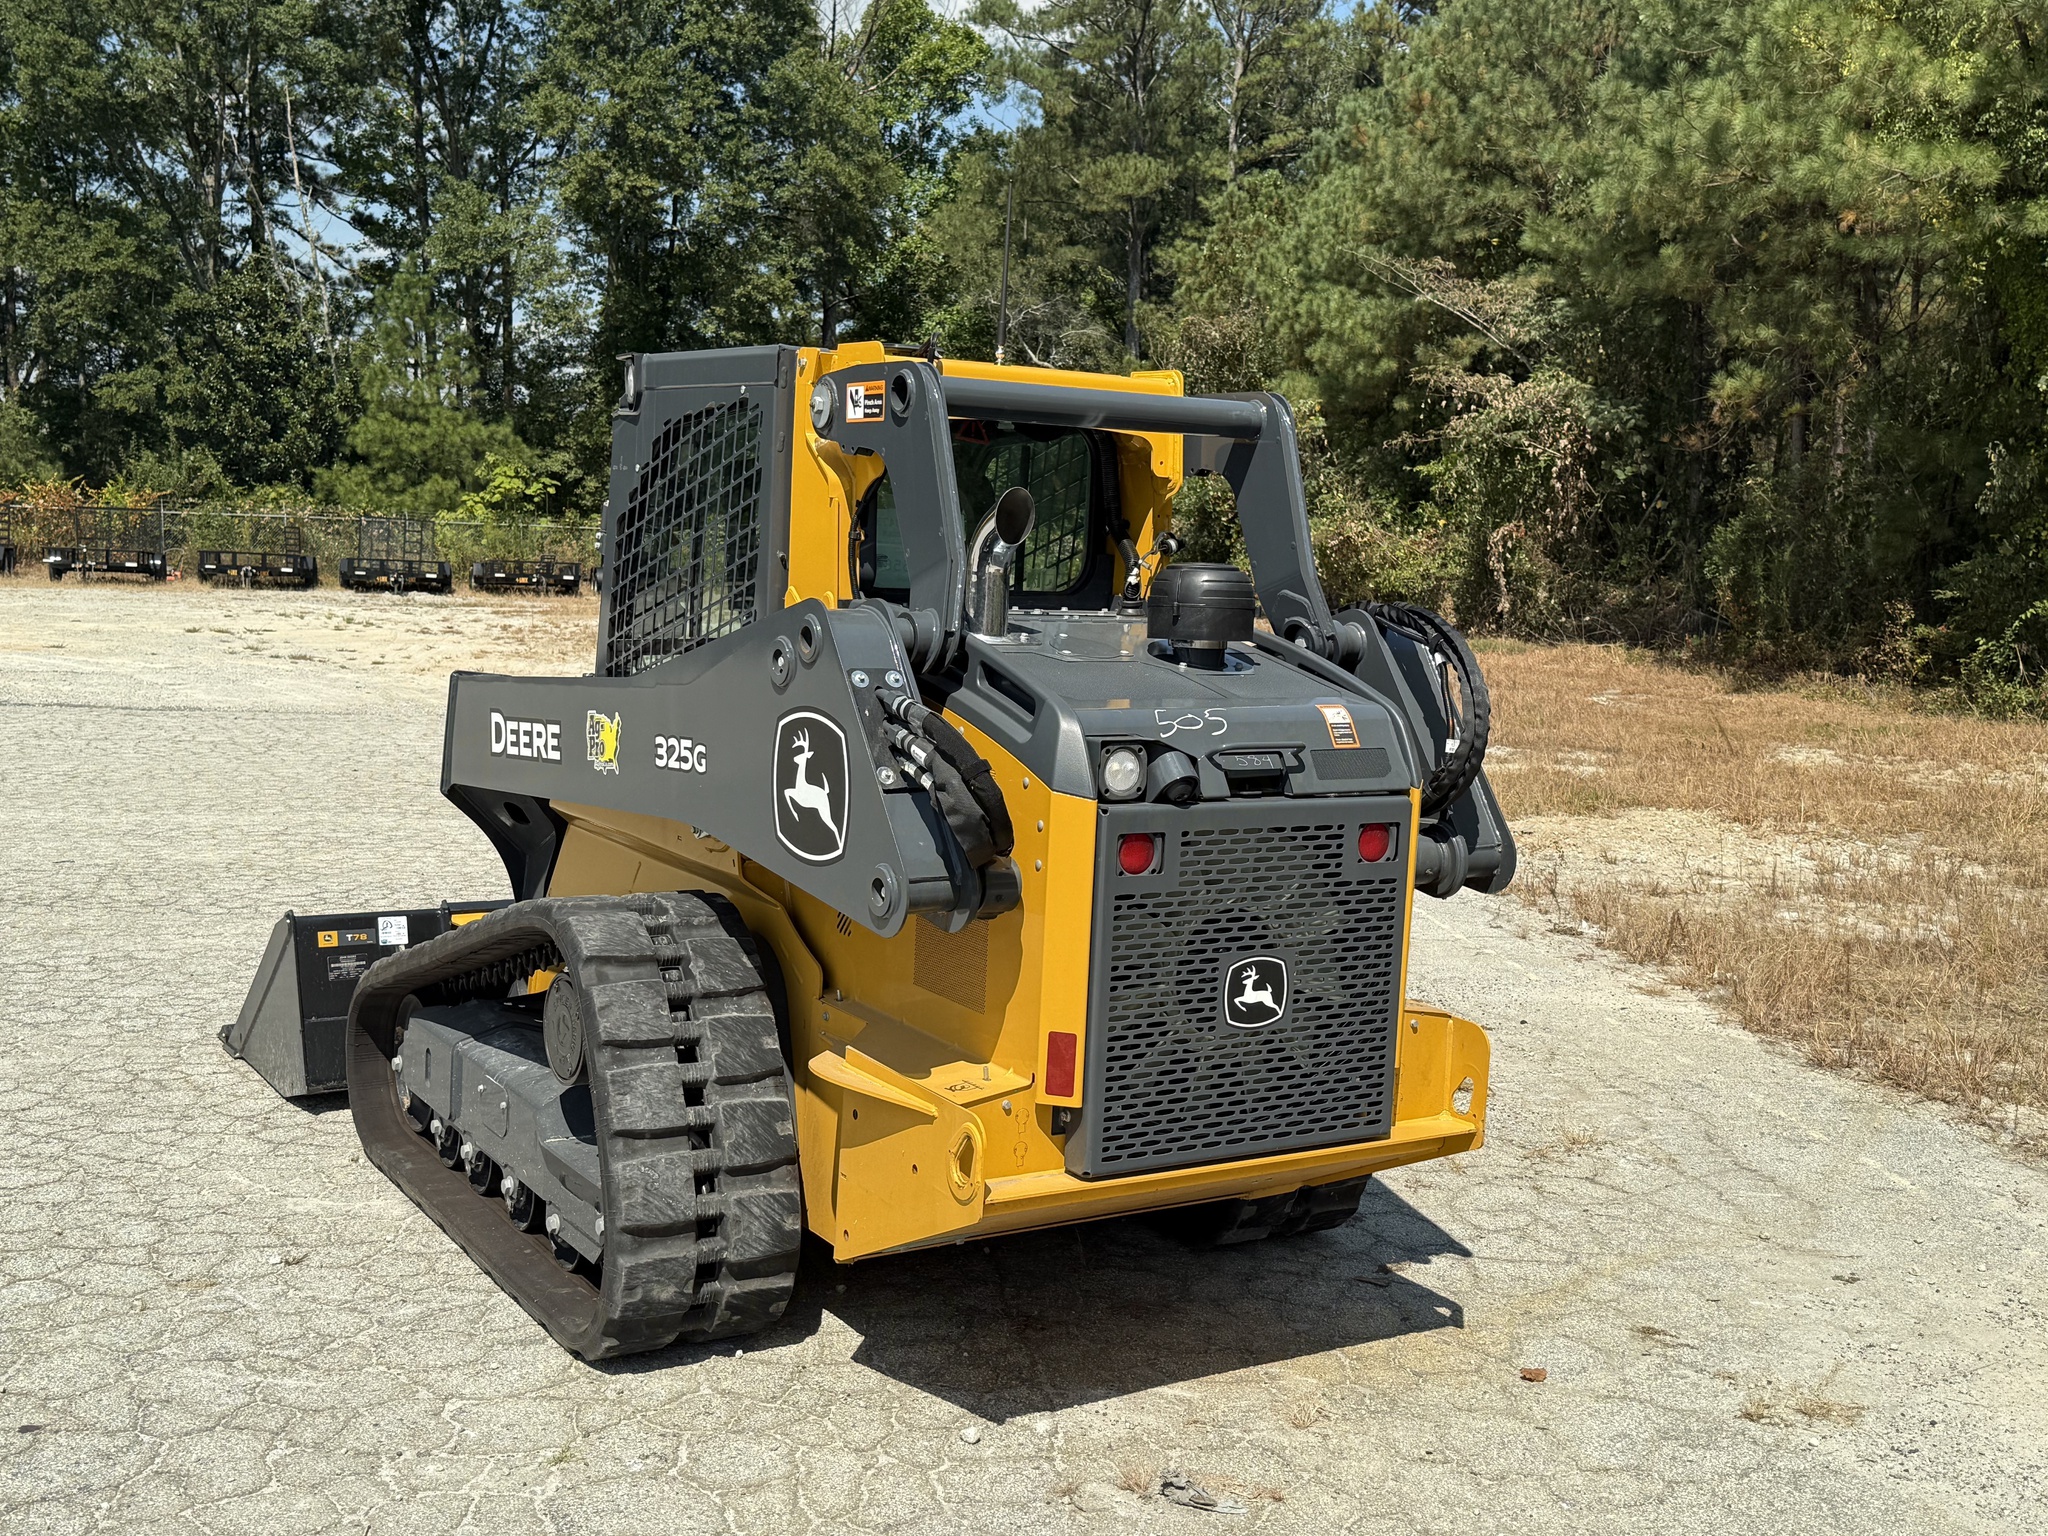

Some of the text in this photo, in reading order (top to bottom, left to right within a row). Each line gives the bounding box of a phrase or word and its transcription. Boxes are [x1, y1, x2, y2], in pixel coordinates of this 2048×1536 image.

[490, 711, 561, 761] DEERE
[1154, 707, 1228, 738] 505
[655, 735, 707, 773] 325G
[1234, 754, 1275, 769] 584
[346, 933, 367, 941] T78
